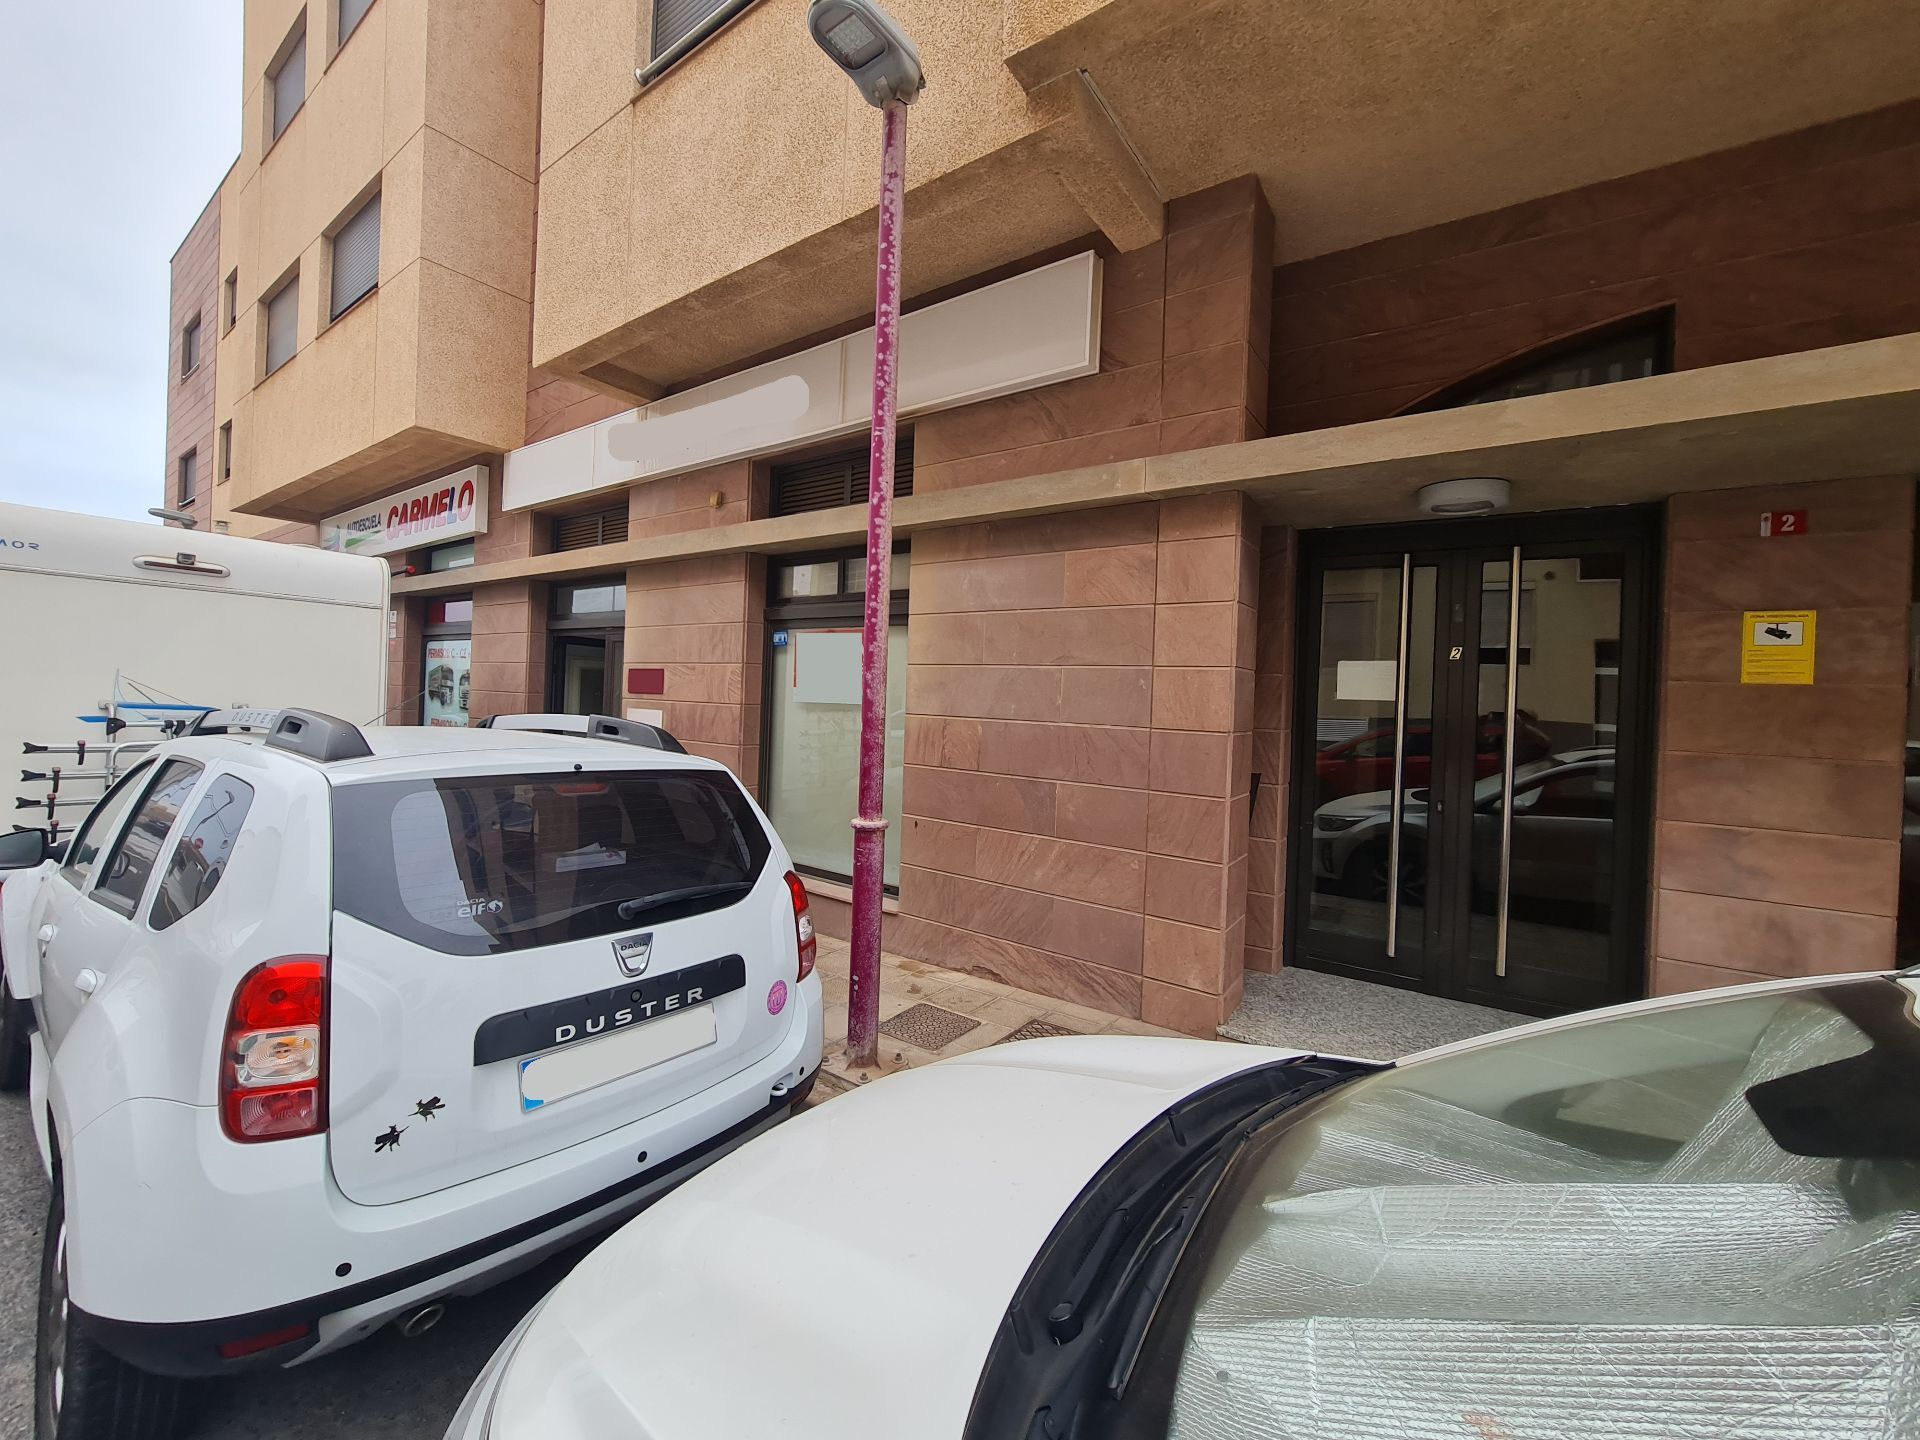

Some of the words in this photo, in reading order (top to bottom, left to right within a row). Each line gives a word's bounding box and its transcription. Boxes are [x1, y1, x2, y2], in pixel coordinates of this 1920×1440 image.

[386, 479, 475, 540] CARMELO
[1781, 514, 1795, 531] 2
[1451, 647, 1461, 659] 2
[457, 902, 487, 918] elf
[620, 941, 650, 951] DACIA
[555, 987, 704, 1043] DUSTER
